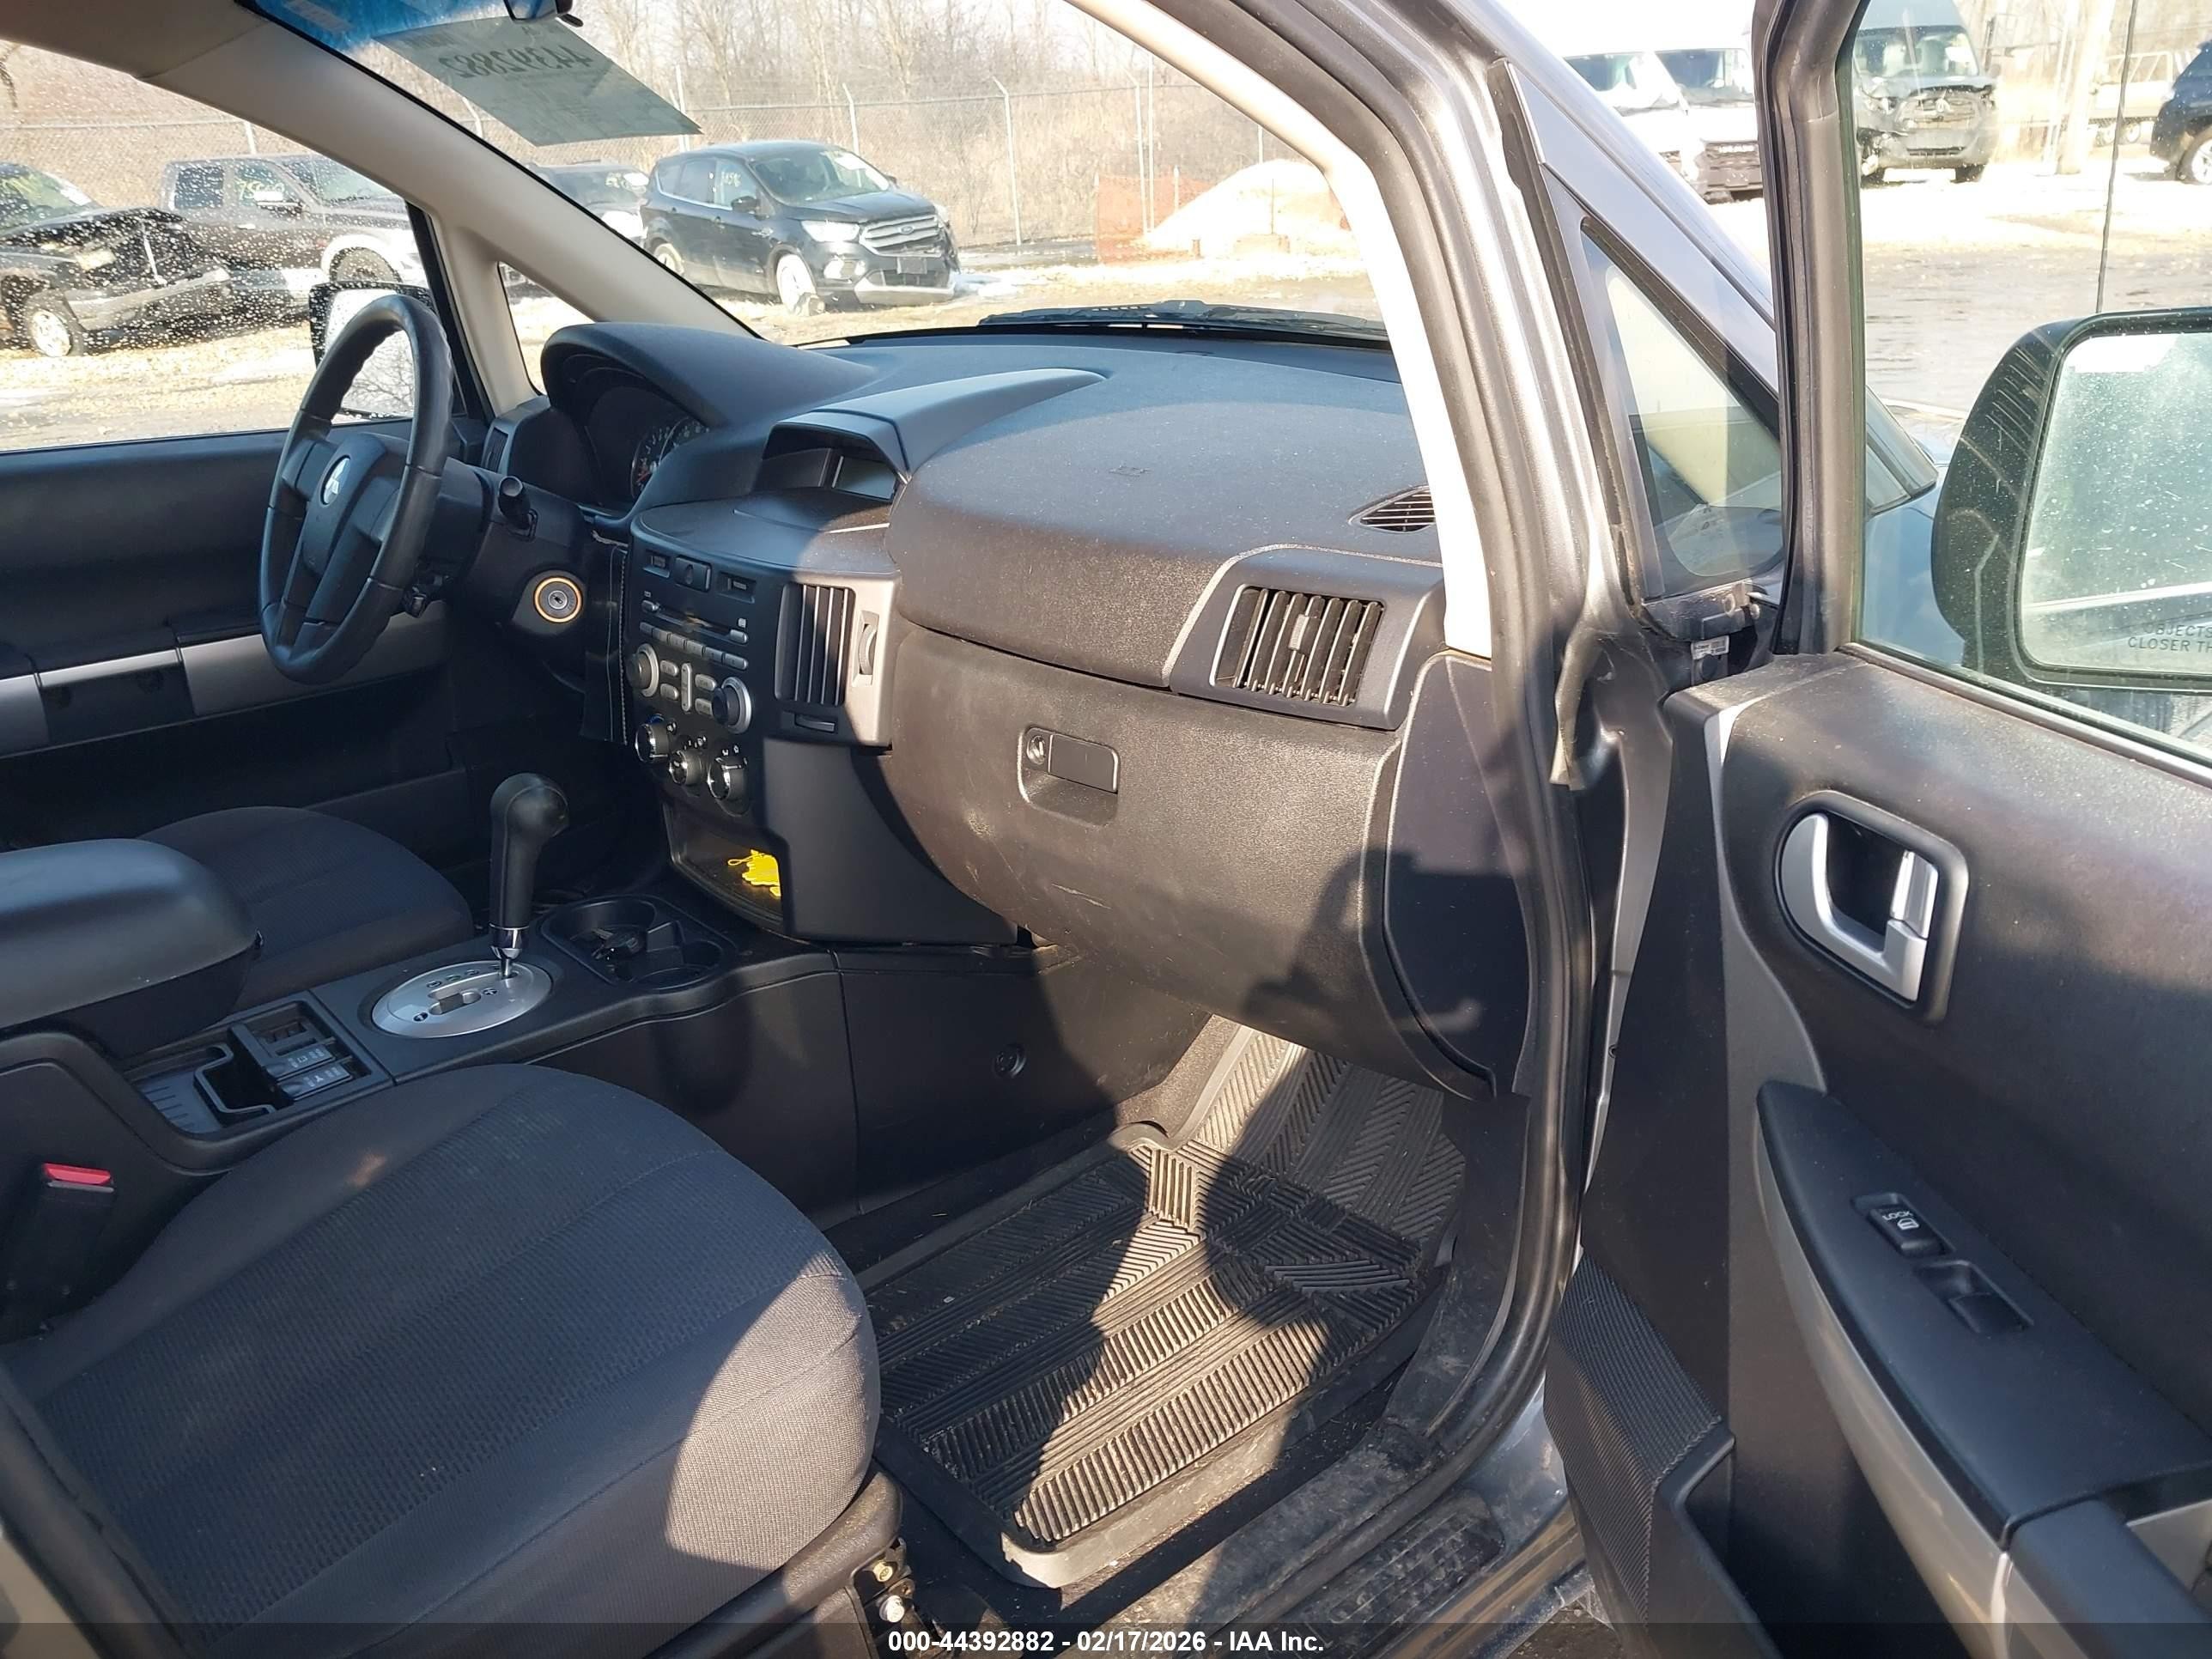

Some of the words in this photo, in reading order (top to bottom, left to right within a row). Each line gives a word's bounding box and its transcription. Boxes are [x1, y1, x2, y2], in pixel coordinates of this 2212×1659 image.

[2143, 623, 2212, 638] OBJECTS
[2128, 636, 2191, 652] CLOSER
[1882, 1211, 1913, 1220] LOCK
